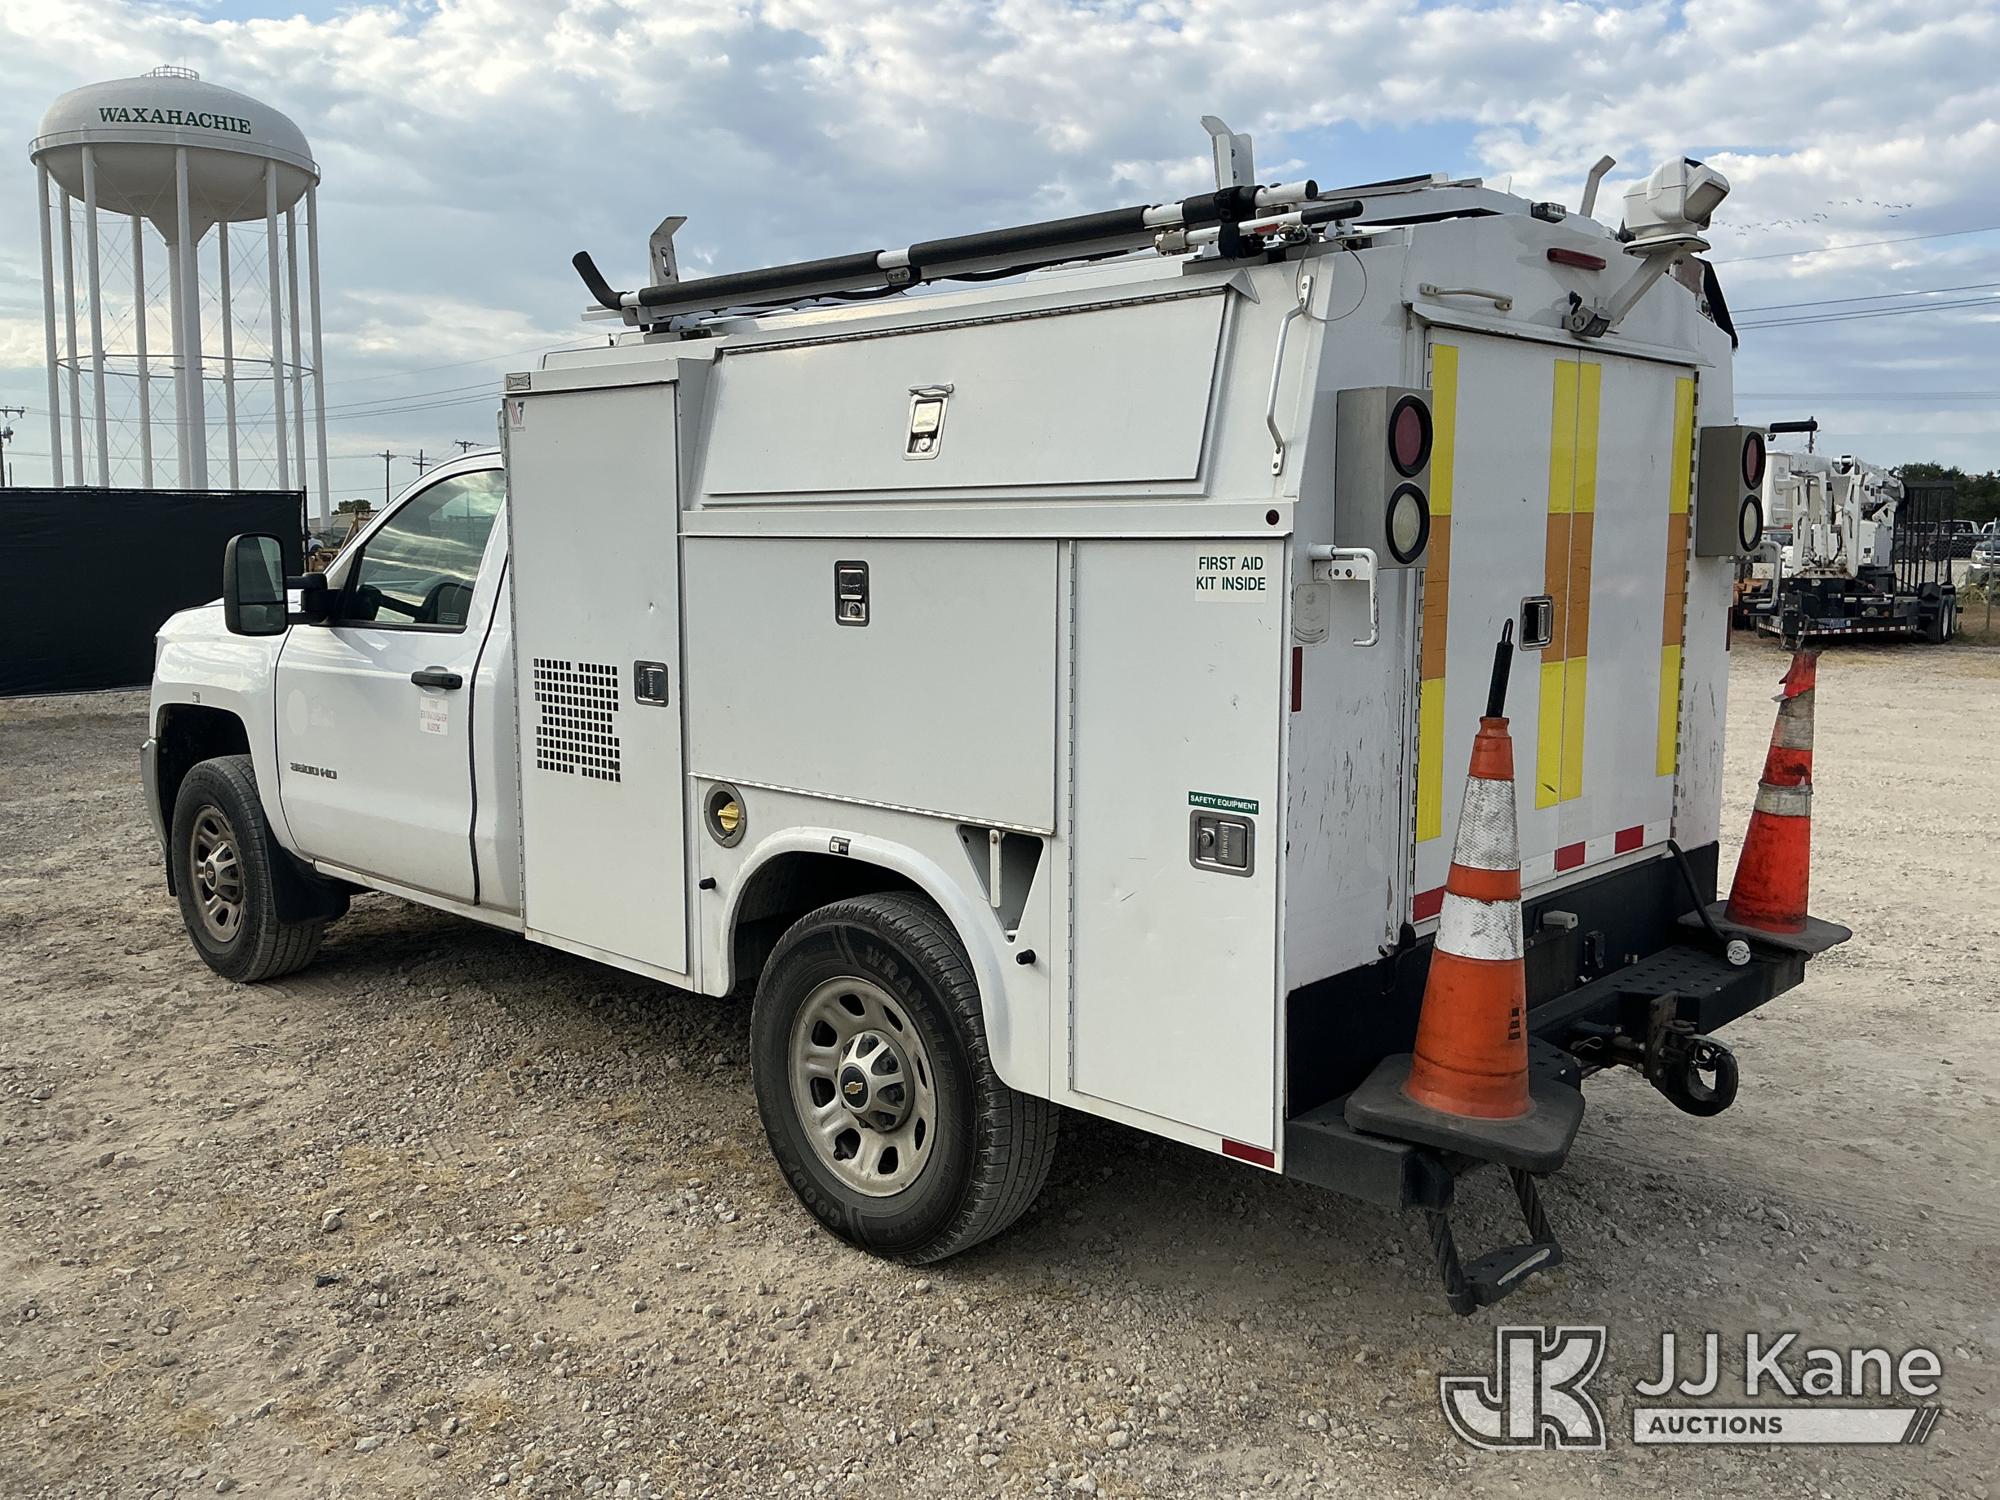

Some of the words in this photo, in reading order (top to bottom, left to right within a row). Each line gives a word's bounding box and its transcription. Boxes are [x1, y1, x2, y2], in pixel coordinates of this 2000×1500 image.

[99, 107, 252, 134] WAXAHACHIE
[1198, 555, 1236, 571] FIRST
[1241, 555, 1264, 571] AID
[1196, 575, 1217, 590] KIT
[1221, 576, 1266, 591] INSIDE
[1190, 794, 1217, 805] SAFETY
[1217, 798, 1258, 811] EQUIPMENT
